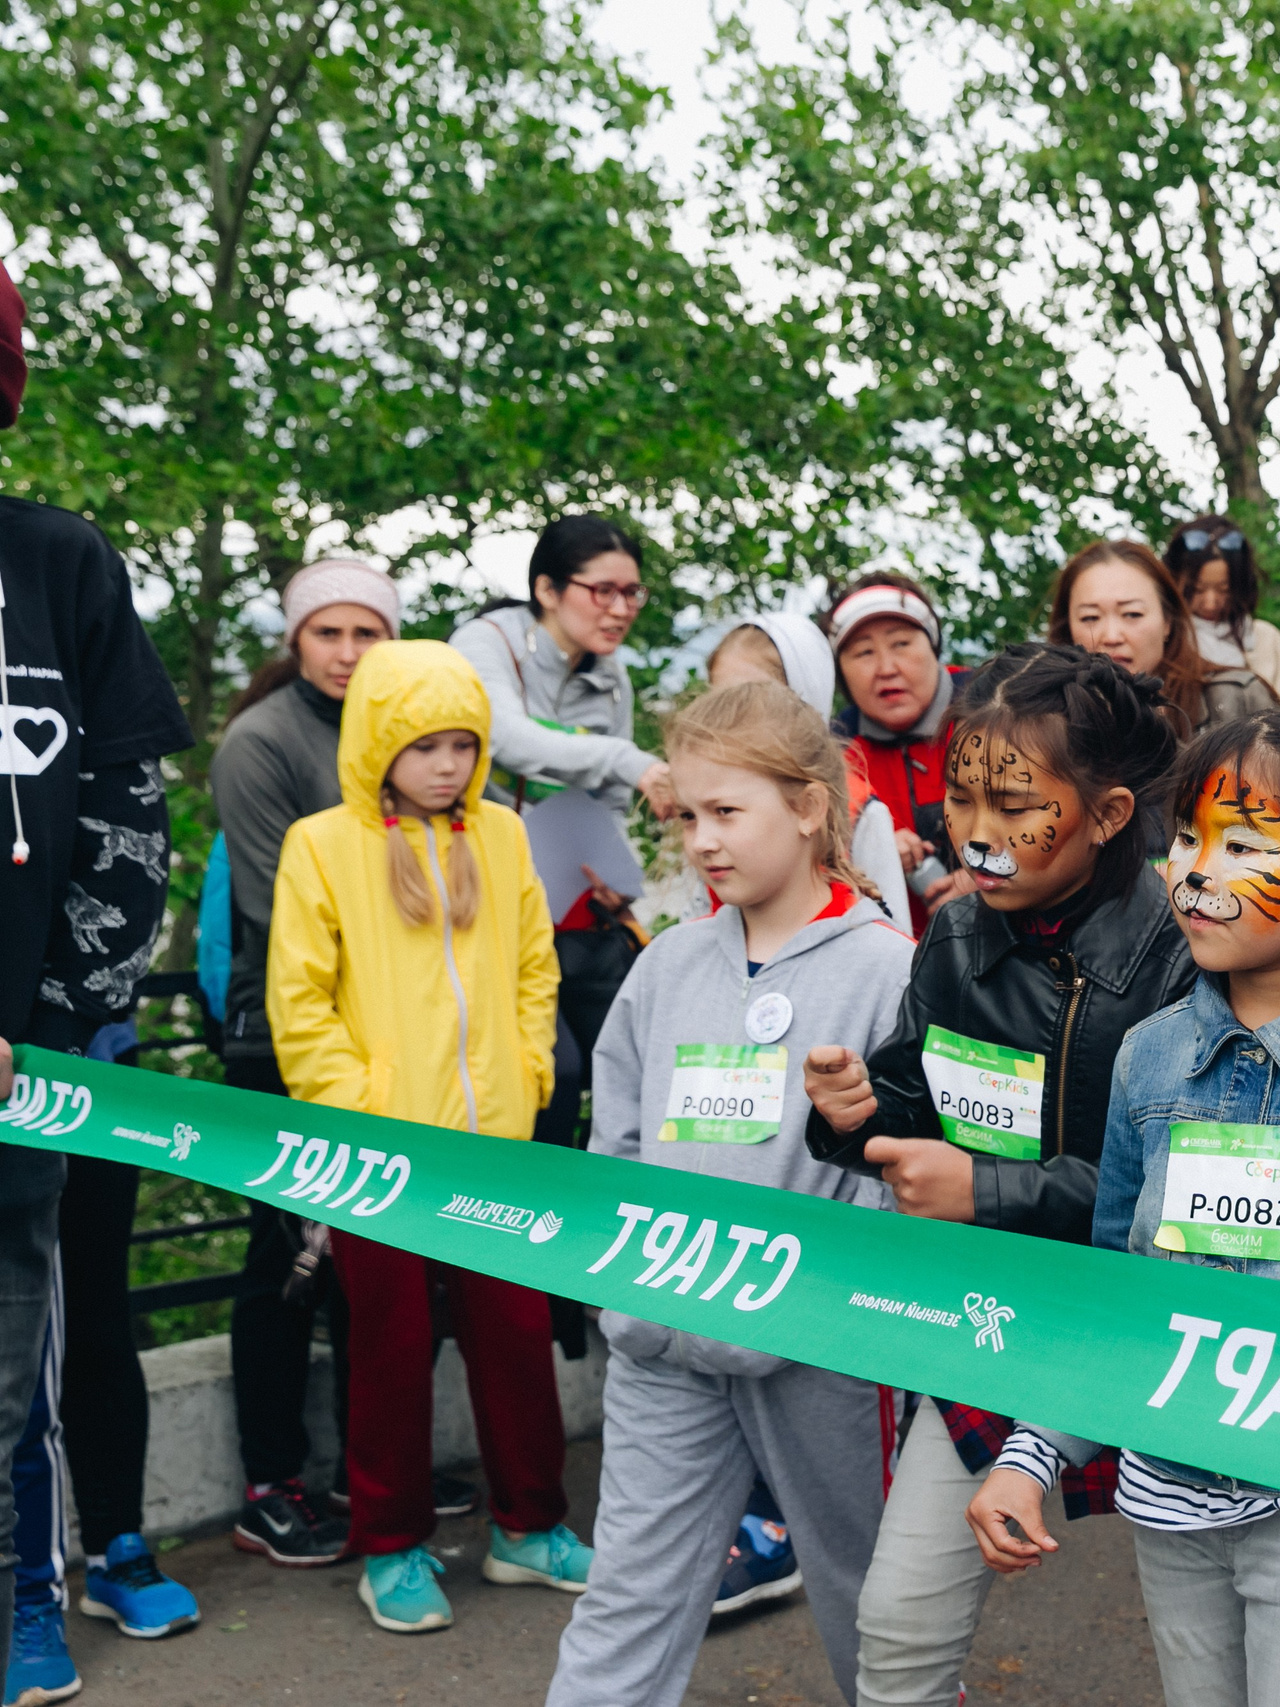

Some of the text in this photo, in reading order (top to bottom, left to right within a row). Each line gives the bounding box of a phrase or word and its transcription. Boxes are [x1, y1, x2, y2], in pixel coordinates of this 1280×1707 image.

[681, 1096, 754, 1117] P-0090
[940, 1091, 1014, 1129] P-0083
[1211, 1228, 1262, 1247] бежим
